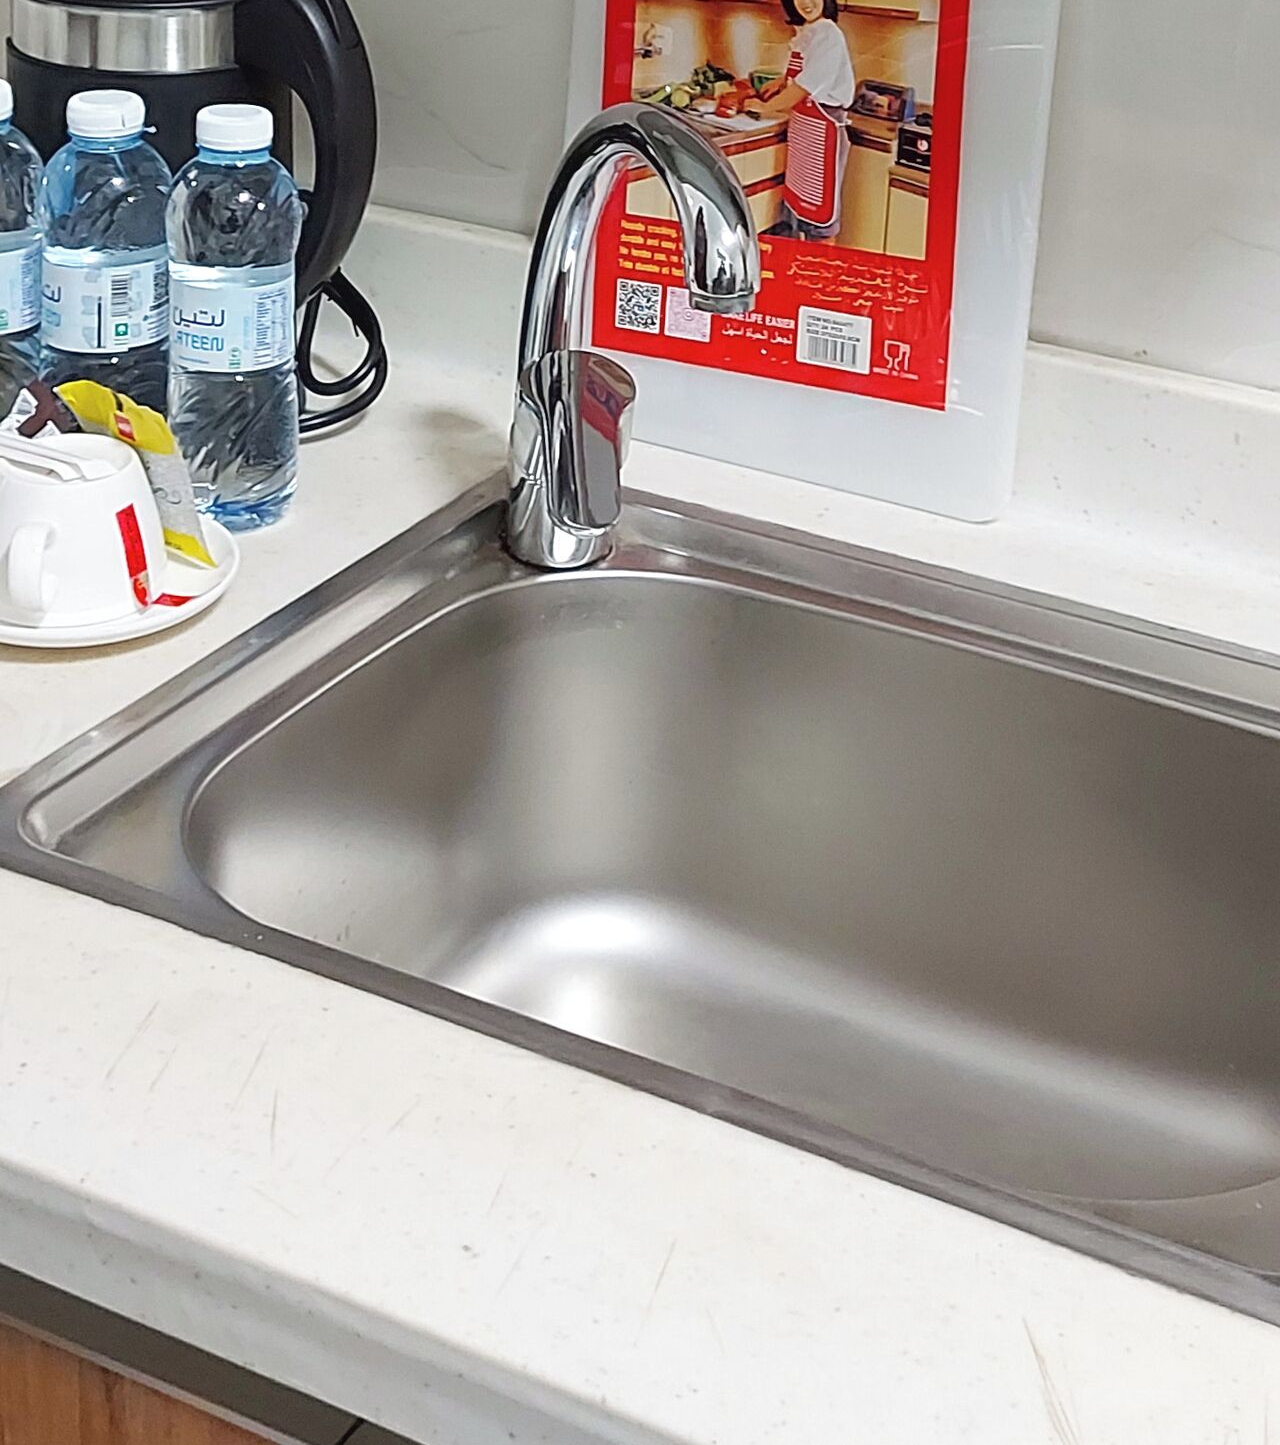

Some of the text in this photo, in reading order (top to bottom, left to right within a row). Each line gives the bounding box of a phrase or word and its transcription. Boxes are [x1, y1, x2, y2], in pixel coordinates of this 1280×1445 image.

[172, 306, 225, 328] لتين
[745, 312, 764, 324] LIFE
[765, 315, 796, 329] EASIER
